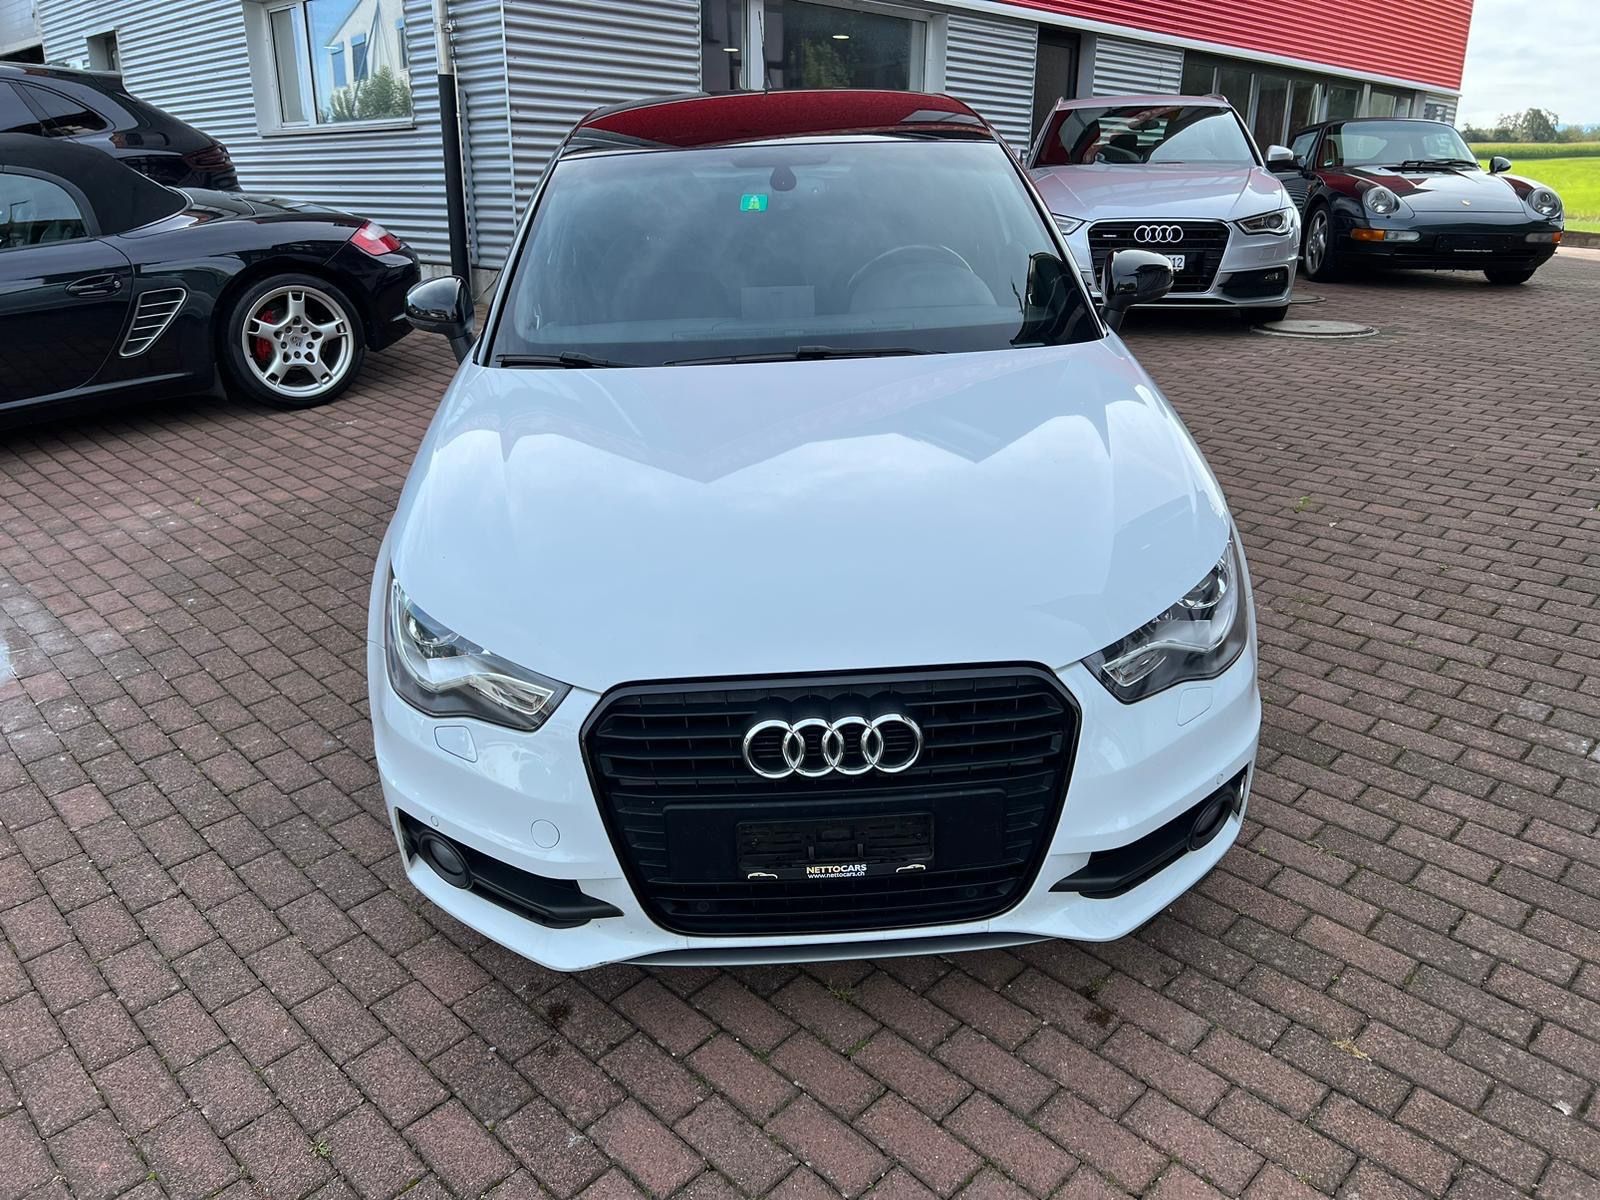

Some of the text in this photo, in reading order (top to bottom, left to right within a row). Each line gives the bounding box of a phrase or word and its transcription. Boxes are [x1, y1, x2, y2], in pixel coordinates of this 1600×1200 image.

[1168, 257, 1184, 268] 12
[806, 864, 867, 874] NETTOCARS
[807, 870, 865, 879] www.nettocars.ch
